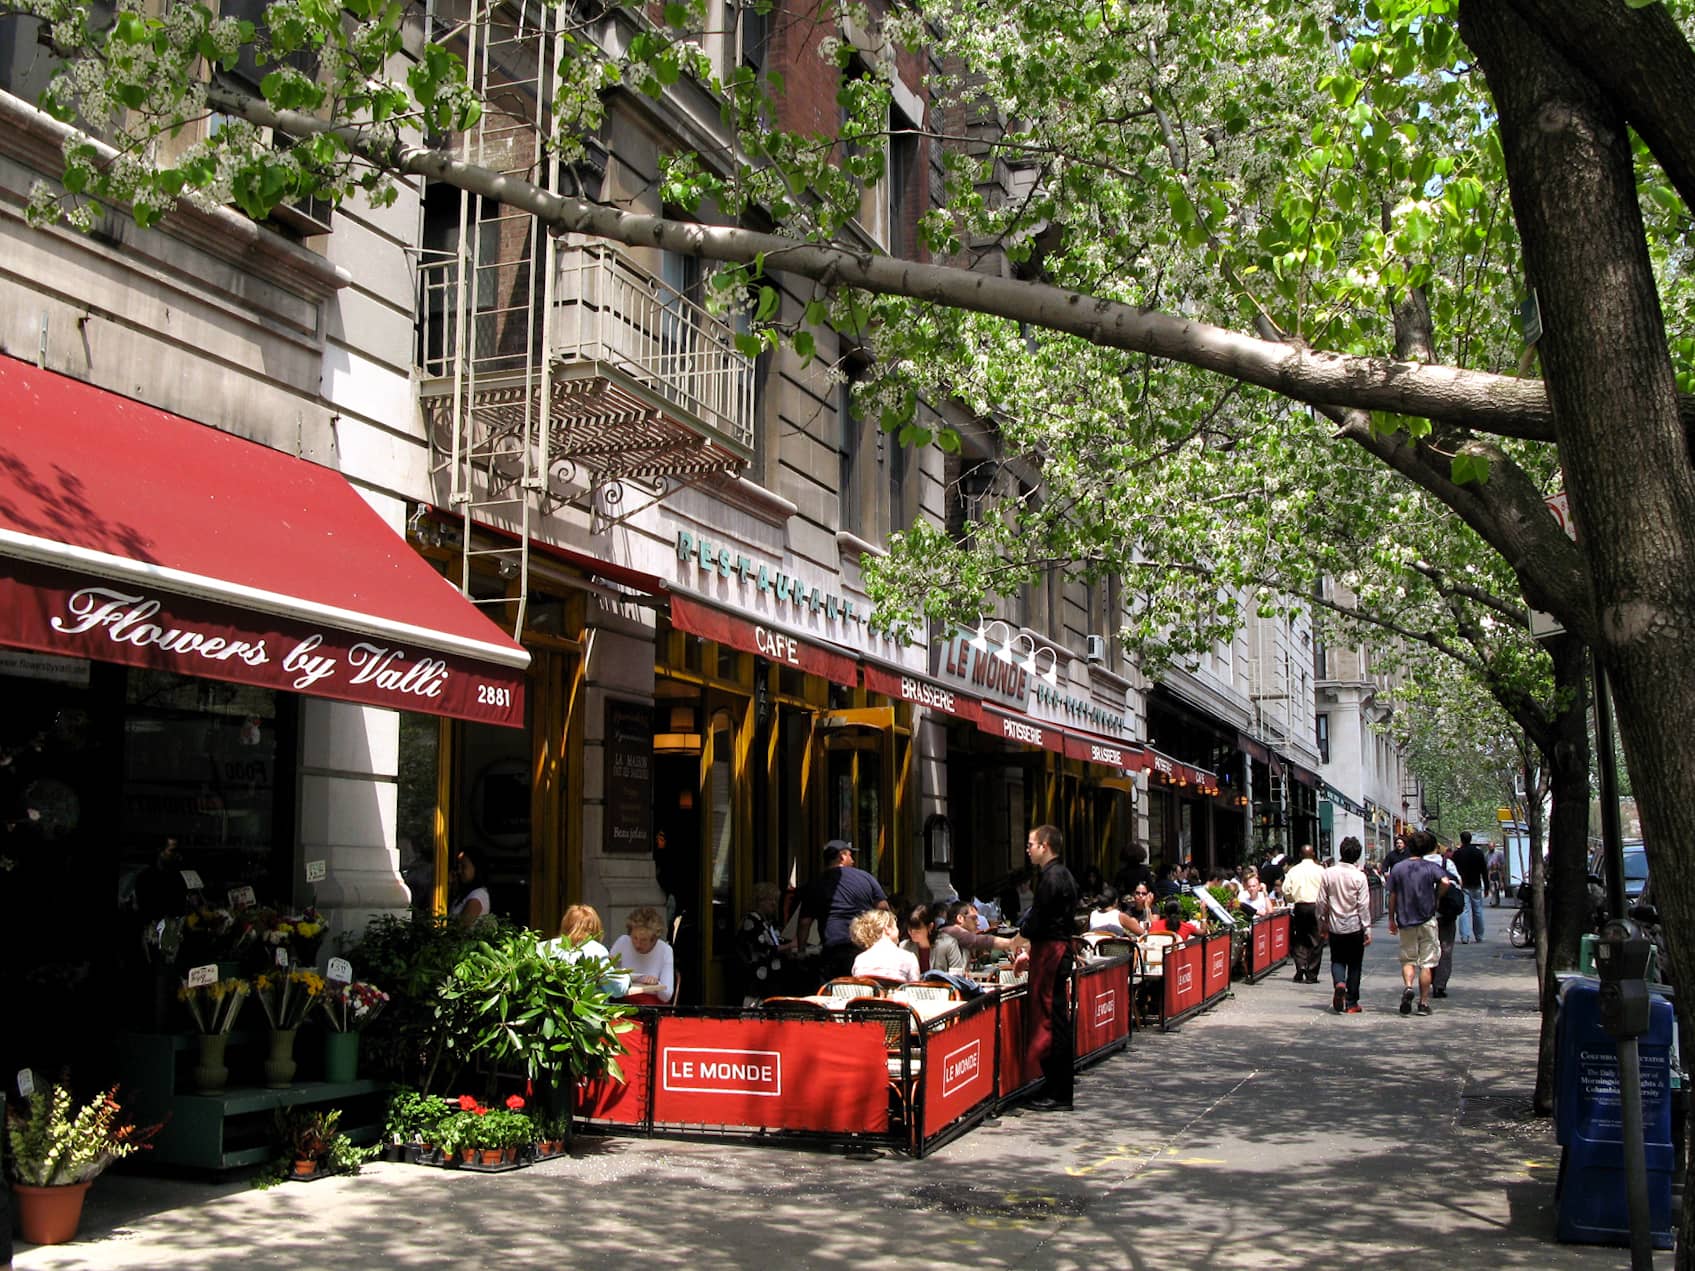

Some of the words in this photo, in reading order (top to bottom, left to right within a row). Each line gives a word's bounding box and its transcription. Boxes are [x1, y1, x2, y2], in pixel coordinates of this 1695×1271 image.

[677, 531, 853, 624] RESTAURANT
[51, 587, 269, 665] Flowers
[283, 634, 336, 689] by
[349, 643, 448, 697] Valli
[946, 638, 969, 679] LE
[973, 647, 1027, 701] MONDE
[478, 685, 510, 708] 2881
[902, 677, 956, 713] BRASSERIE
[672, 1061, 694, 1079] LE
[700, 1062, 772, 1082] MONDE
[946, 1065, 955, 1083] LE
[955, 1053, 977, 1078] MONDE
